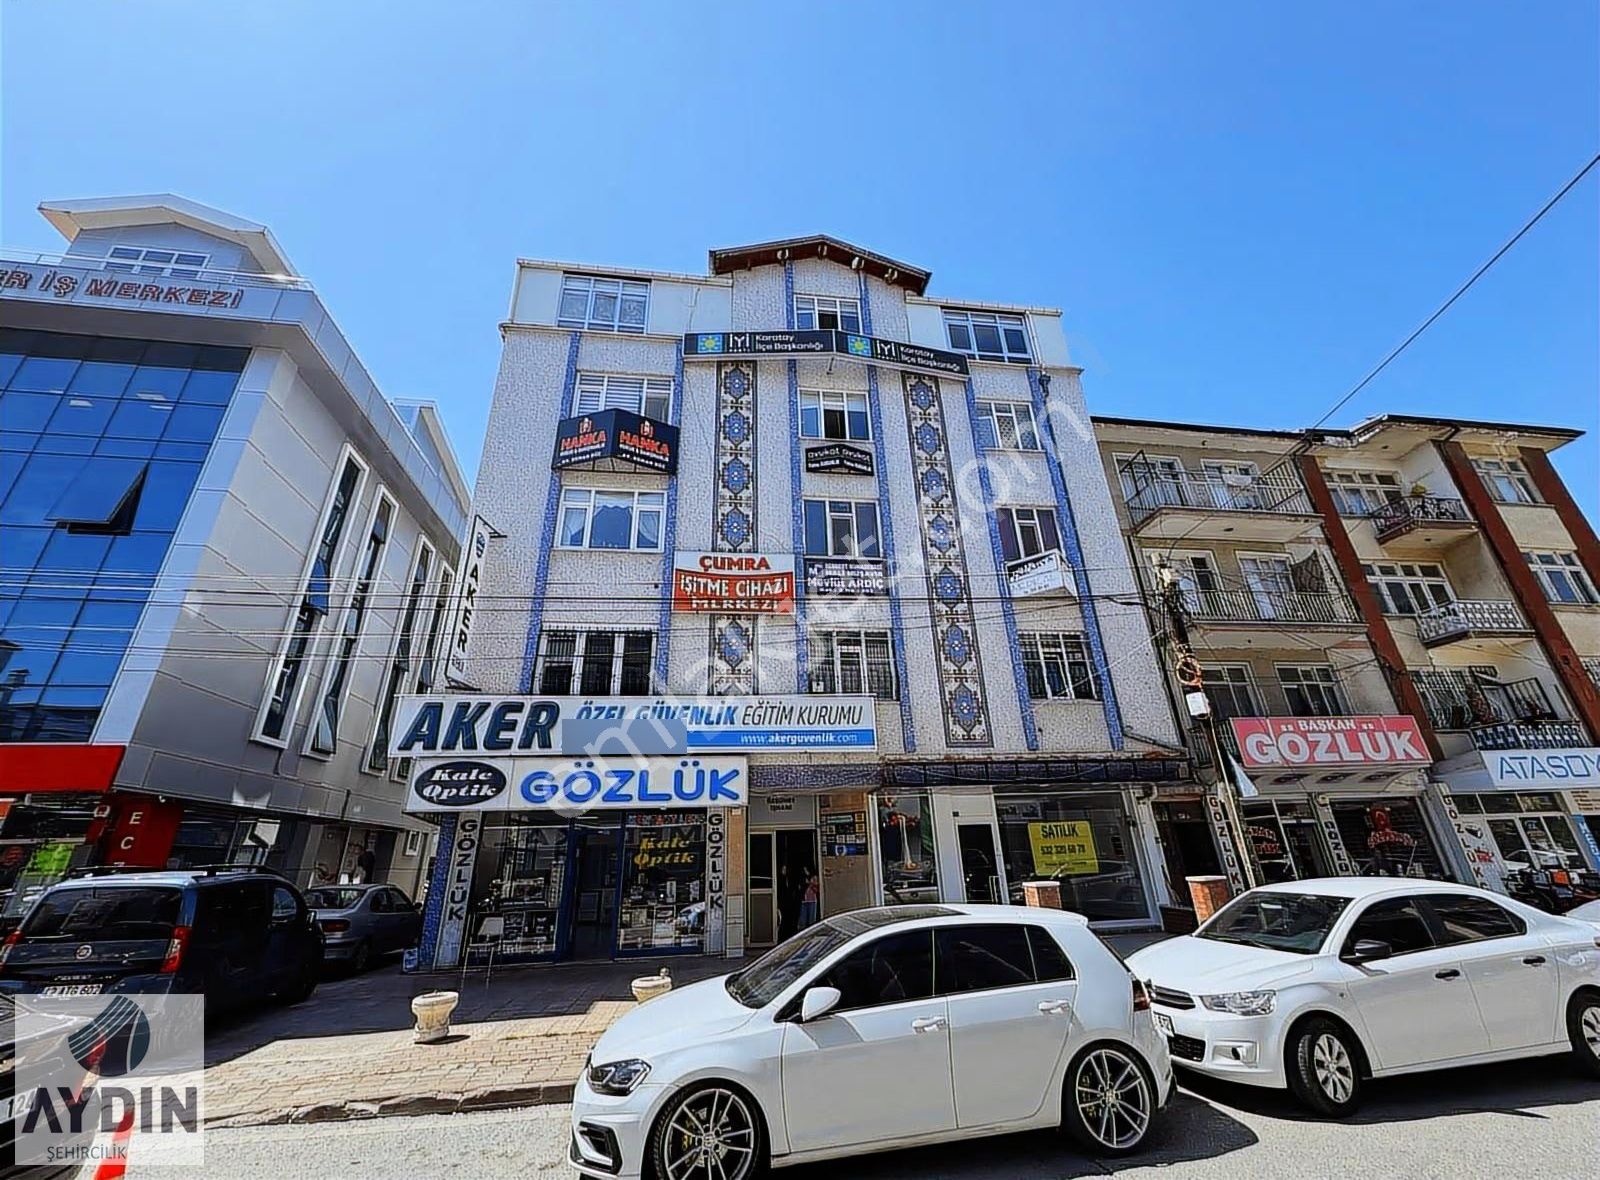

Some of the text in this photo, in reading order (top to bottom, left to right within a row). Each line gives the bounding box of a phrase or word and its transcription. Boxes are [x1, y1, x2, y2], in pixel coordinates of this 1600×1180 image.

[39, 268, 77, 298] İŞ
[85, 277, 244, 309] MERKEZİ
[755, 334, 795, 342] Karatay
[699, 555, 771, 572] ÇUMRA
[680, 574, 788, 597] İŞİTME CİHAZI
[742, 699, 792, 726] EĞİTİM
[796, 704, 863, 725] KURUMU
[397, 700, 561, 751] AKER
[1299, 719, 1357, 733] BAŞKAN
[429, 768, 494, 782] Kale
[520, 761, 740, 804] GÖZLÜK
[422, 783, 497, 803] Optik
[1041, 823, 1079, 839] SATILIK
[448, 819, 478, 921] GÖZLÜK
[708, 813, 723, 909] GÖZLÜK
